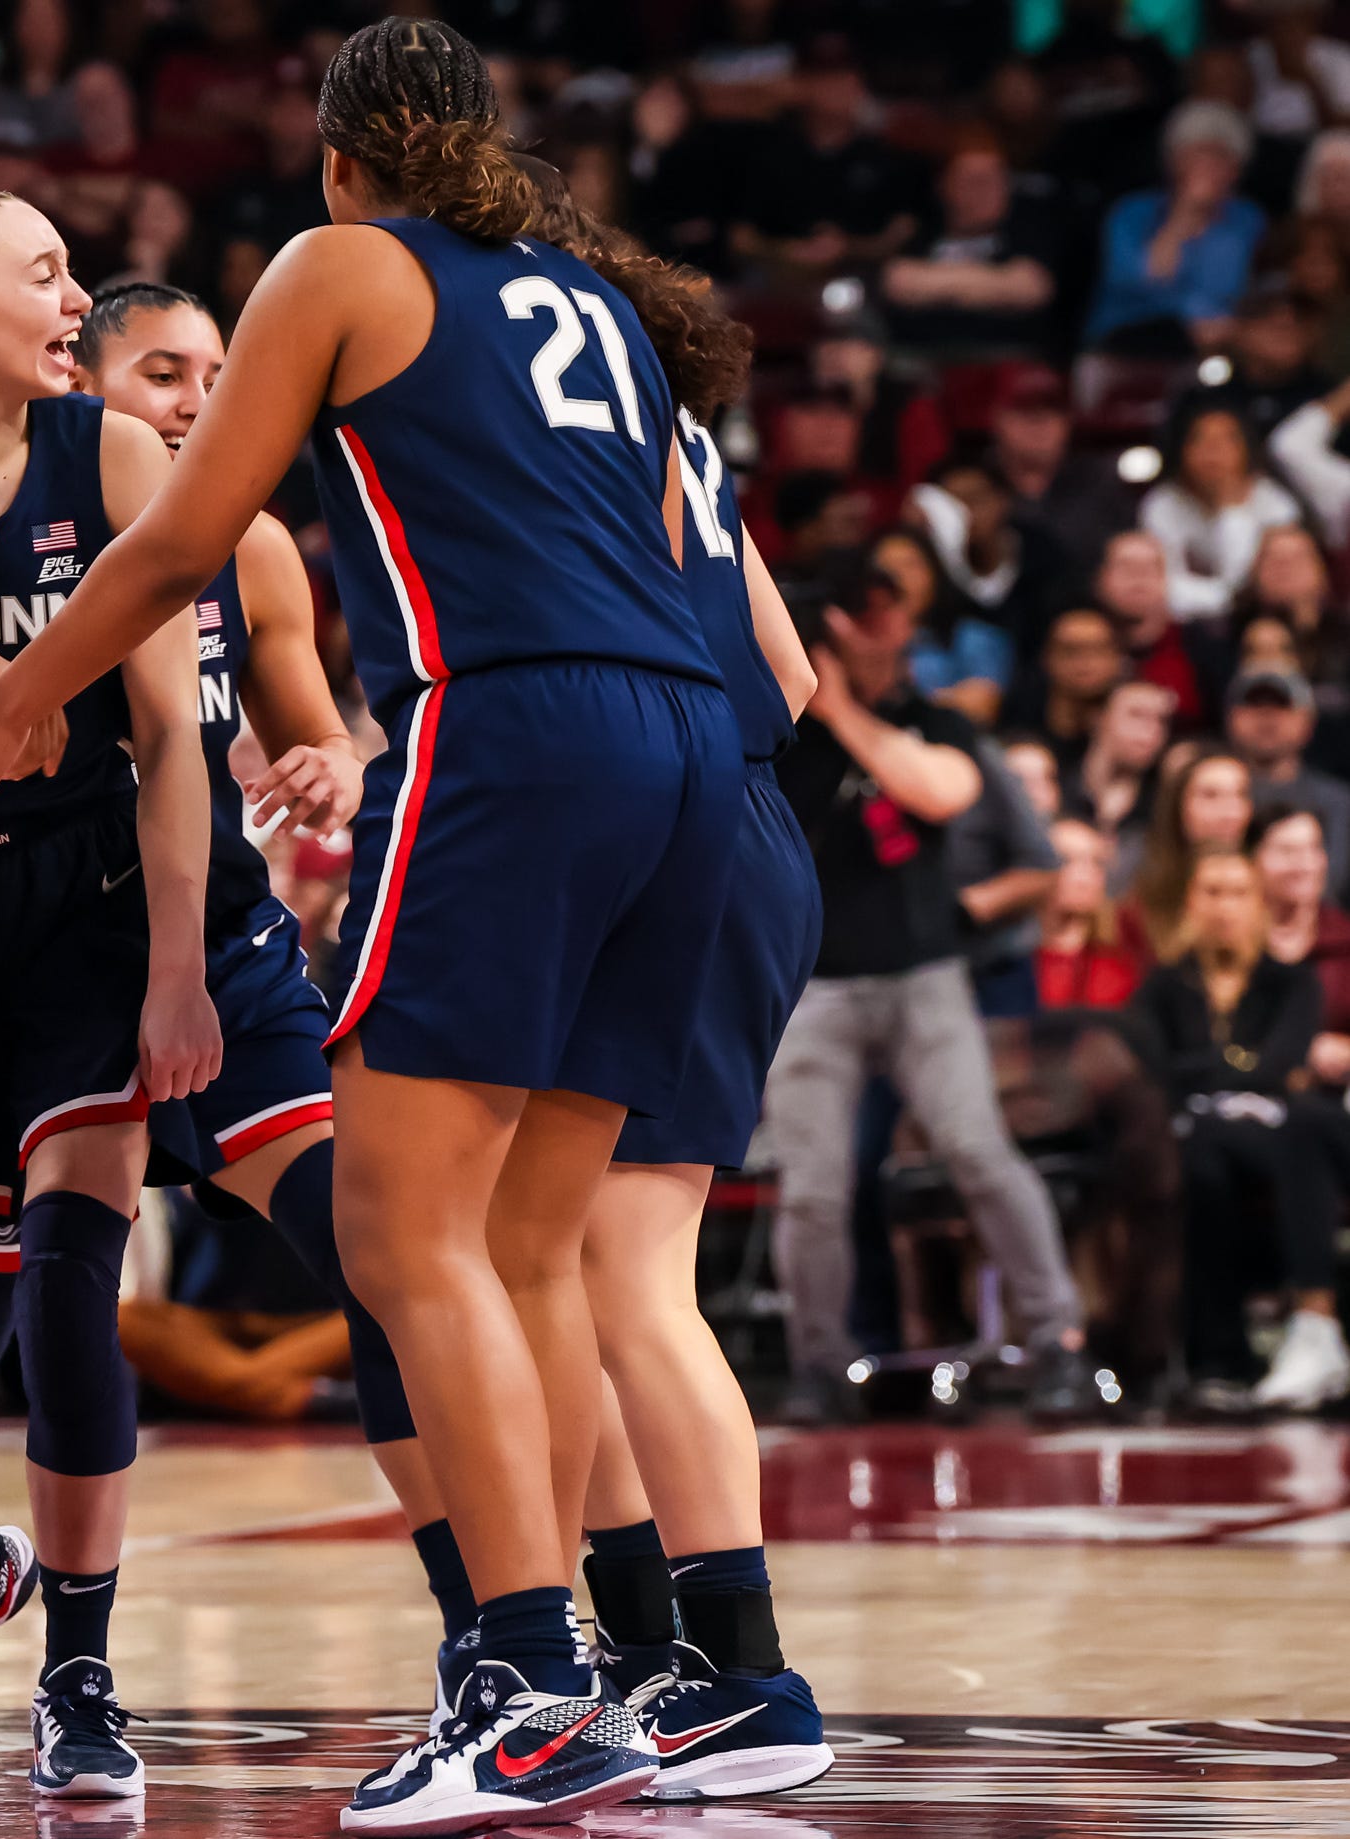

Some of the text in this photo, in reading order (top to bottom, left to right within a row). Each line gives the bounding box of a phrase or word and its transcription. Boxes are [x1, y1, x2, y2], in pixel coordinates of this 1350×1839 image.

[498, 275, 646, 446] 21
[41, 555, 75, 569] BIG
[38, 564, 84, 578] EAST
